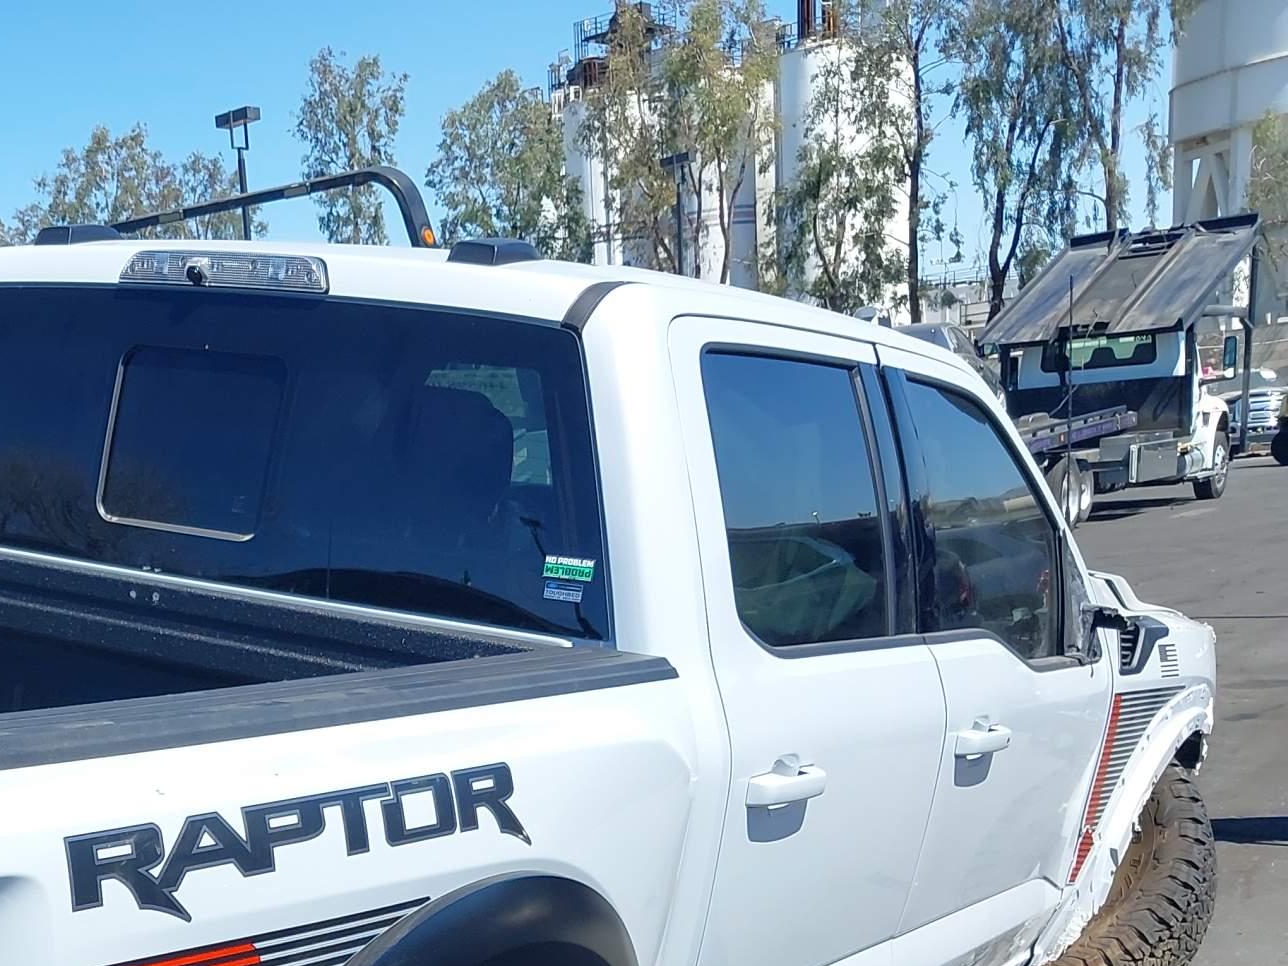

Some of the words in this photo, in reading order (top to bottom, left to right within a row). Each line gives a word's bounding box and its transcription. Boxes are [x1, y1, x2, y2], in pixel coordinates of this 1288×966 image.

[545, 555, 557, 565] NO
[557, 556, 595, 568] PROBLEM
[545, 565, 592, 578] PROBLEM
[64, 761, 532, 923] RAPTOR
